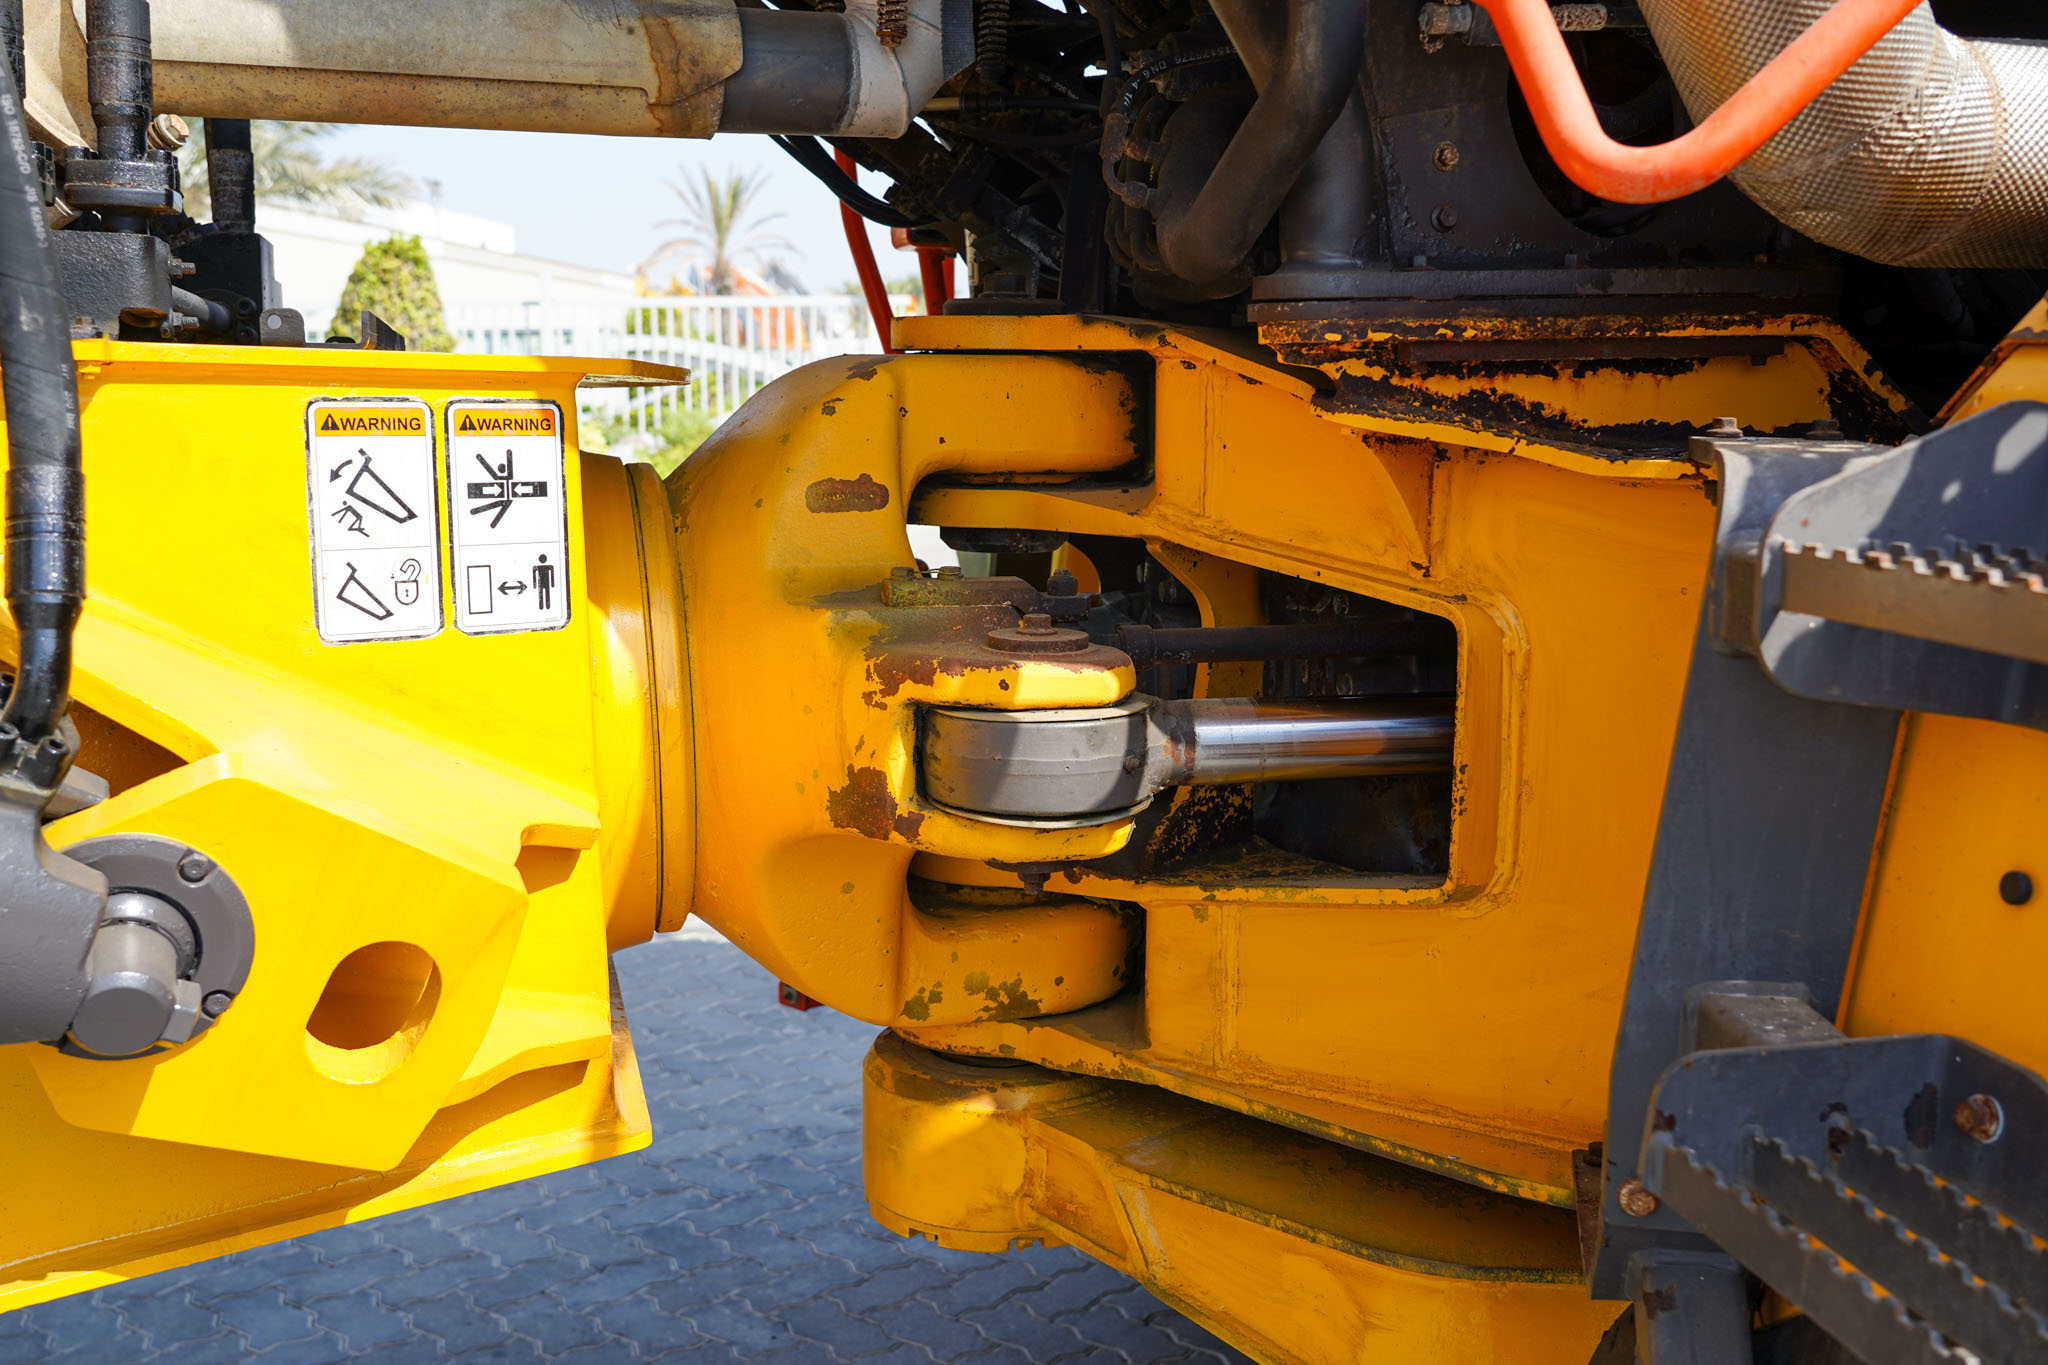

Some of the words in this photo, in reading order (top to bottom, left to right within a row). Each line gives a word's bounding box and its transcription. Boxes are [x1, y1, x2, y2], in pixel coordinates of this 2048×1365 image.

[1152, 61, 1167, 74] DN
[340, 417, 421, 430] WARNING
[477, 417, 551, 430] WARNING
